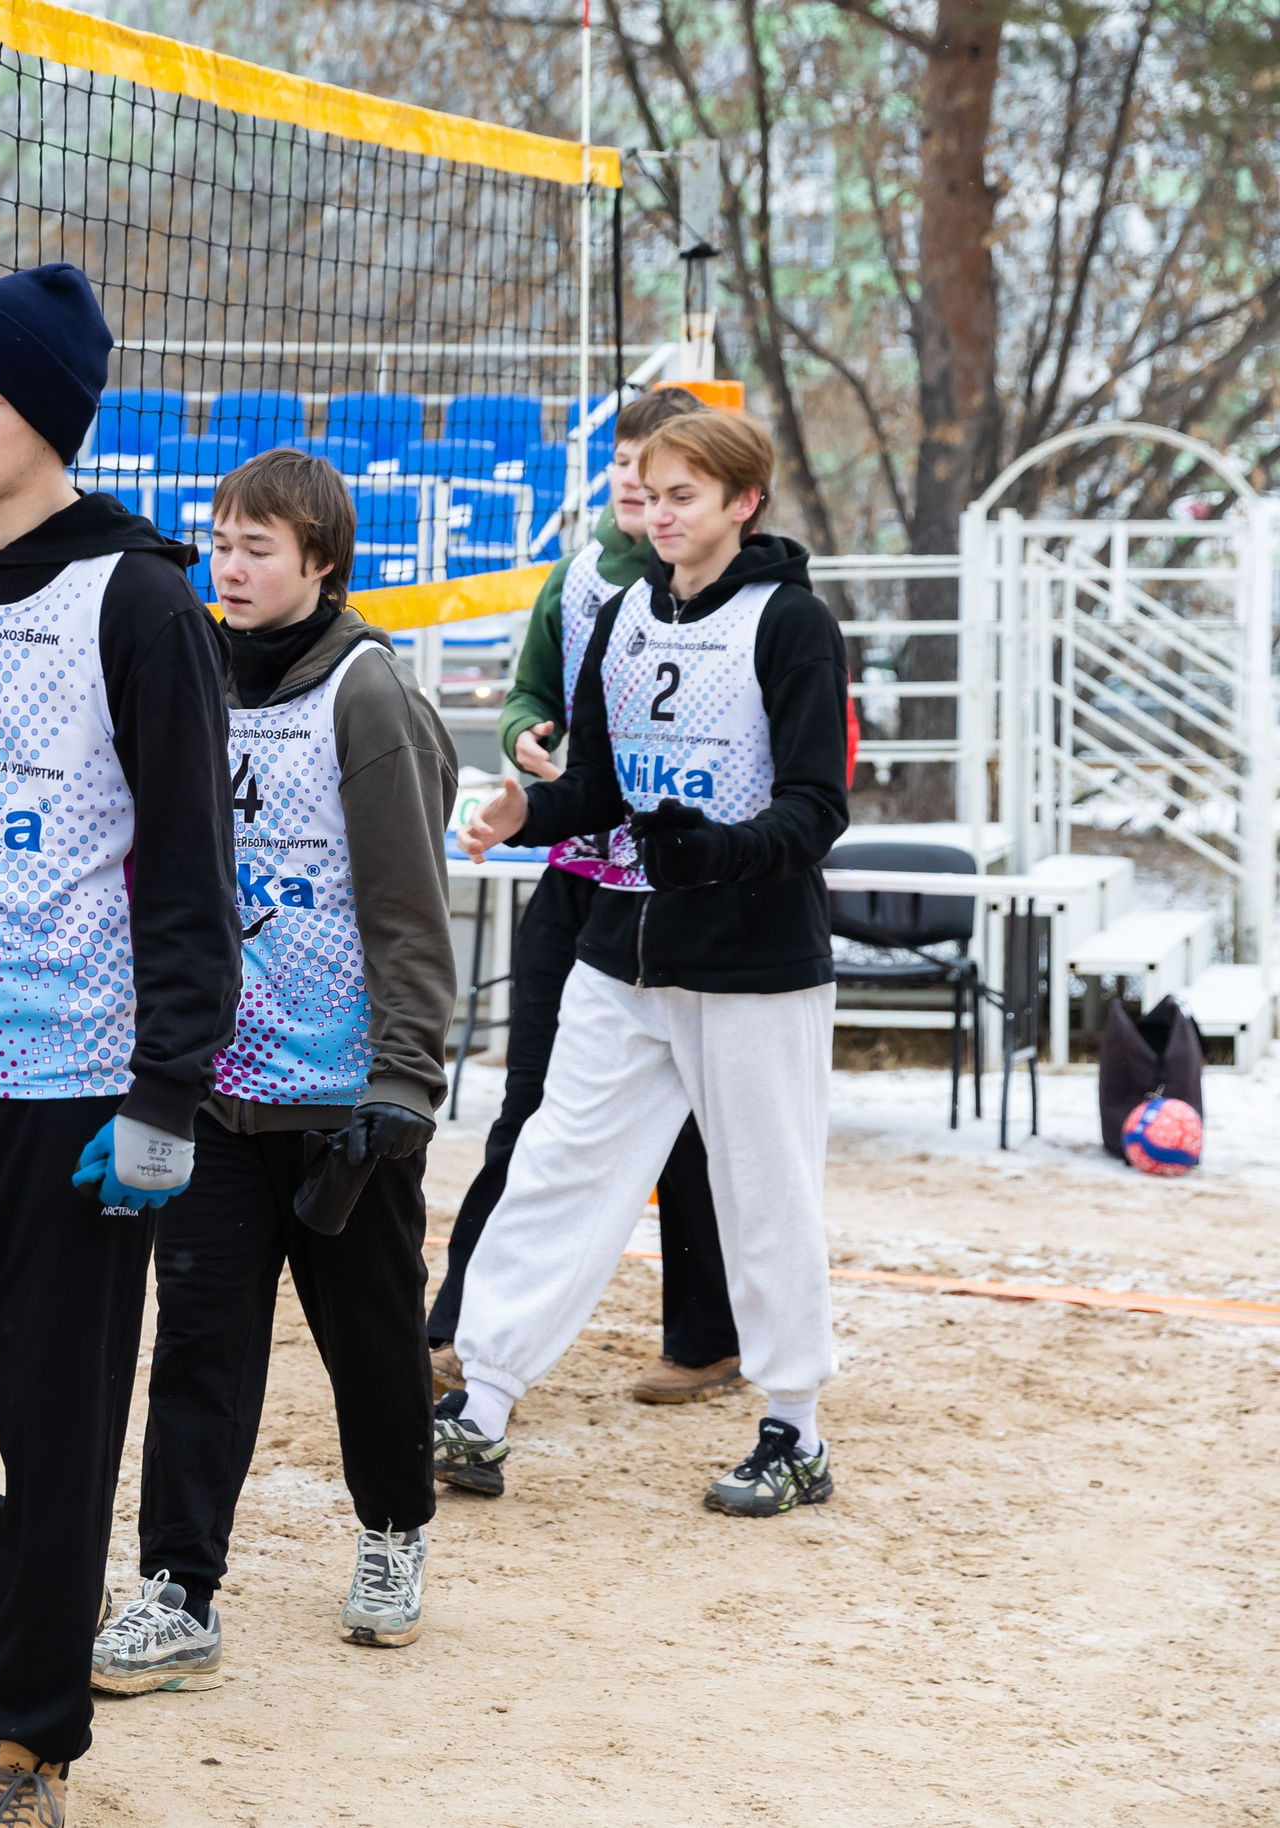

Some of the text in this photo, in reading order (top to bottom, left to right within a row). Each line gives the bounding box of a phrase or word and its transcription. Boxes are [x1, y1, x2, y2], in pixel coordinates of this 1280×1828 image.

[648, 639, 728, 652] РоссельхозБанк
[650, 662, 681, 722] 2
[230, 728, 312, 740] оссельхозБанк
[11, 763, 65, 781] УДМУРТИИ
[233, 753, 264, 824] 4
[234, 837, 328, 850] ЕЙБОЛА УДМУРТИИ
